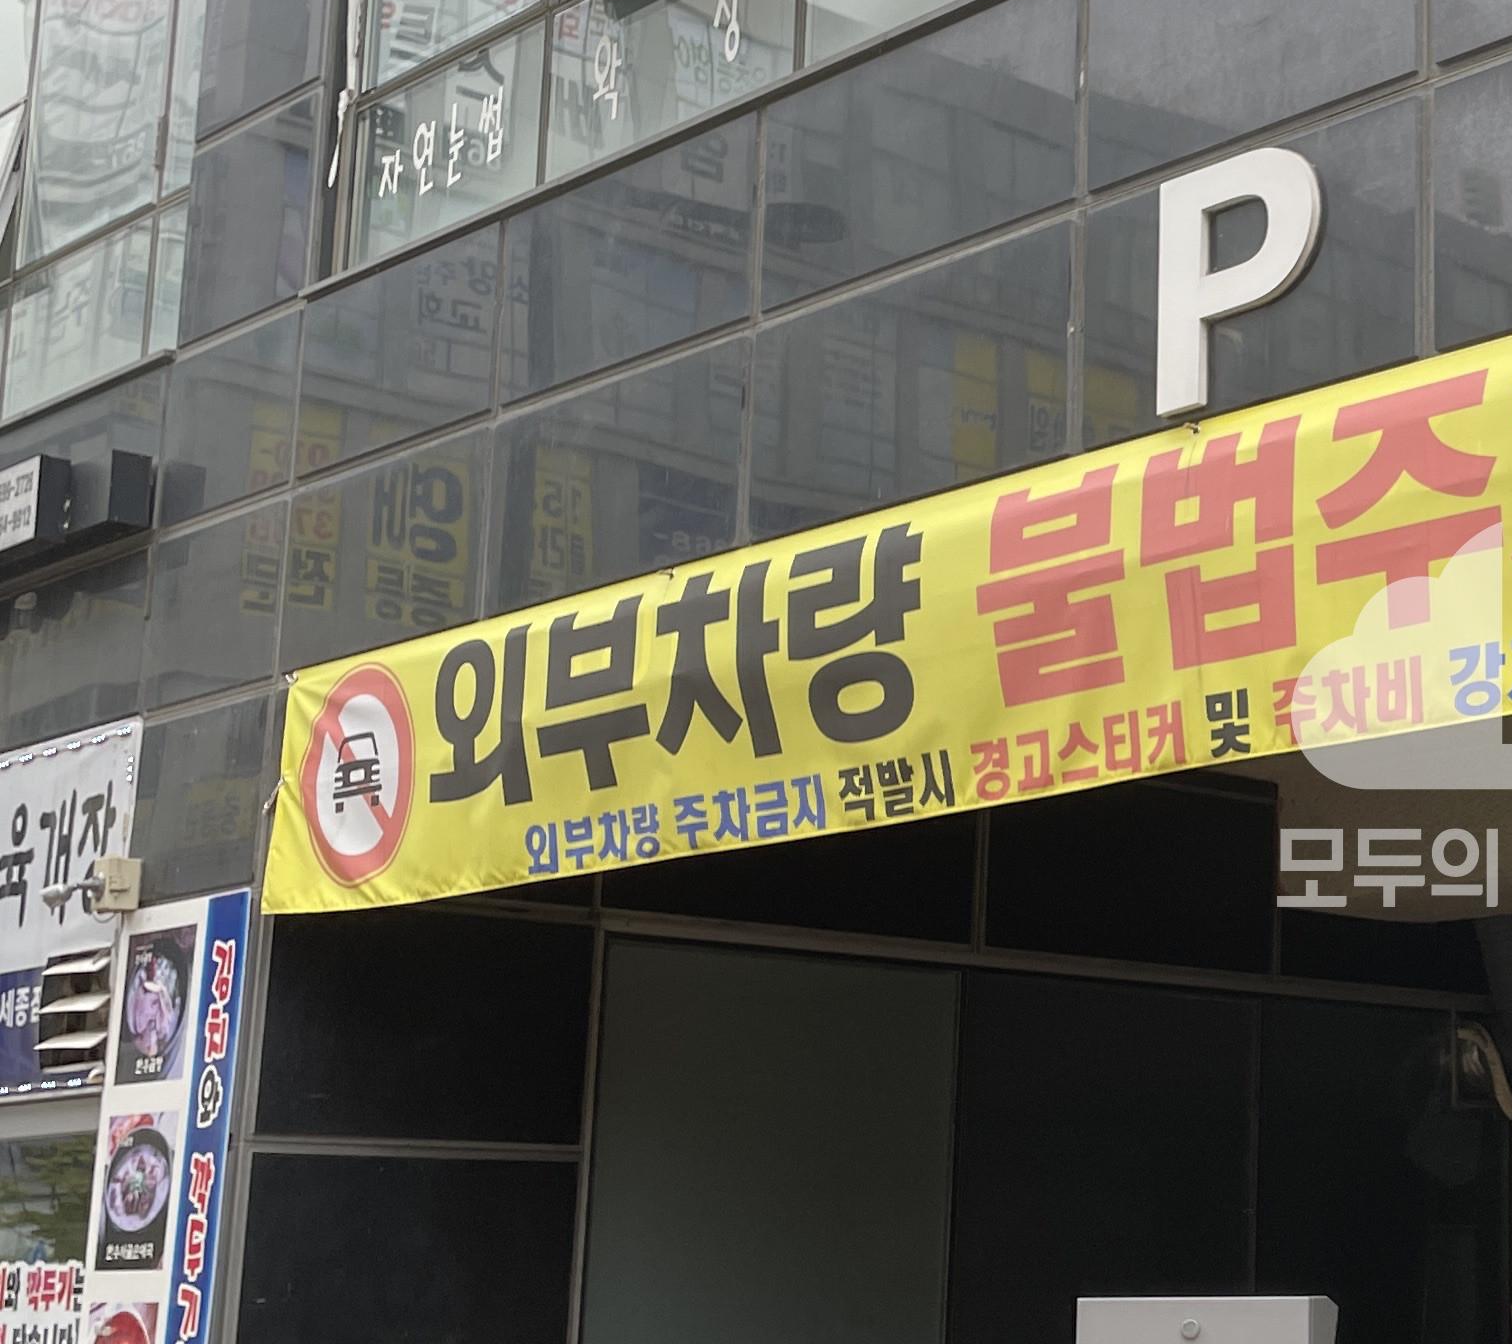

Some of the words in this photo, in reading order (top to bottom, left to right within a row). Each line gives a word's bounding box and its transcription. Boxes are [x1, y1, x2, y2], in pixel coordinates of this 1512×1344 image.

[378, 85, 504, 198] 자연눈썹
[1155, 145, 1322, 419] P
[429, 521, 922, 807] 외부차량
[525, 803, 660, 876] 외부차량
[674, 772, 827, 851] 주차금지
[839, 749, 956, 822] 적발시
[971, 701, 1185, 803] 경고스티커
[1206, 687, 1251, 759] 및
[1273, 654, 1425, 746] 주차비
[198, 938, 236, 1128] 김치와
